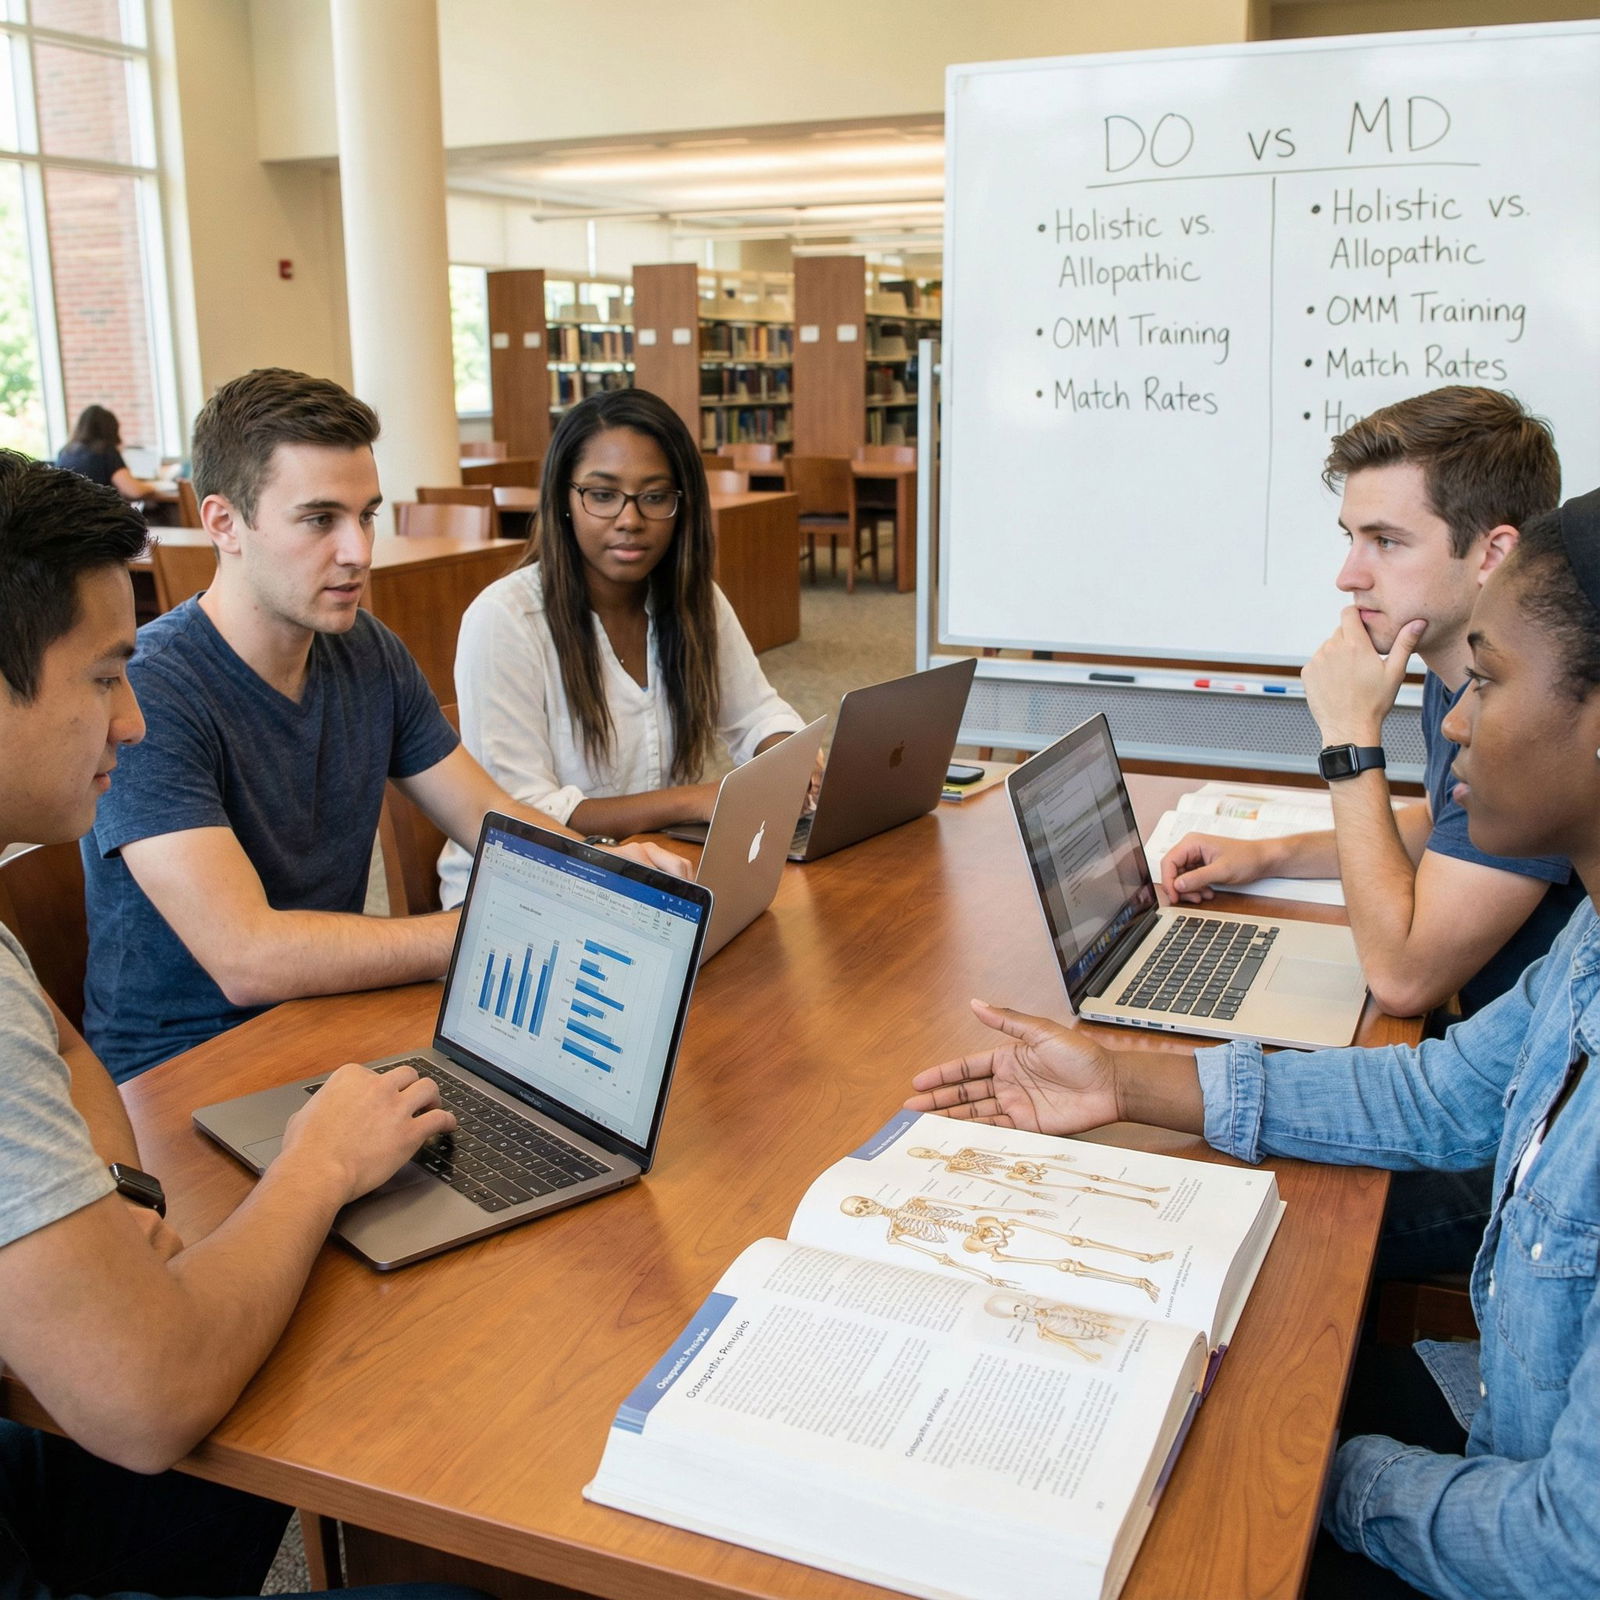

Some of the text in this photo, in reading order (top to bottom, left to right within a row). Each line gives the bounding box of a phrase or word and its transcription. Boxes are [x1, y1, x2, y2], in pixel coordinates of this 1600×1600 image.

[1103, 95, 1452, 173] DO vs MD
[1054, 207, 1216, 244] Holistic vs.
[1332, 187, 1532, 225] Holistic vs.
[1057, 252, 1202, 296] Allopathic
[1329, 234, 1486, 278] Allopathic
[1326, 290, 1528, 343] OMM Training
[1051, 312, 1232, 366] OMM Training
[1325, 344, 1509, 382] Match Rates
[1053, 375, 1220, 416] Match Rates
